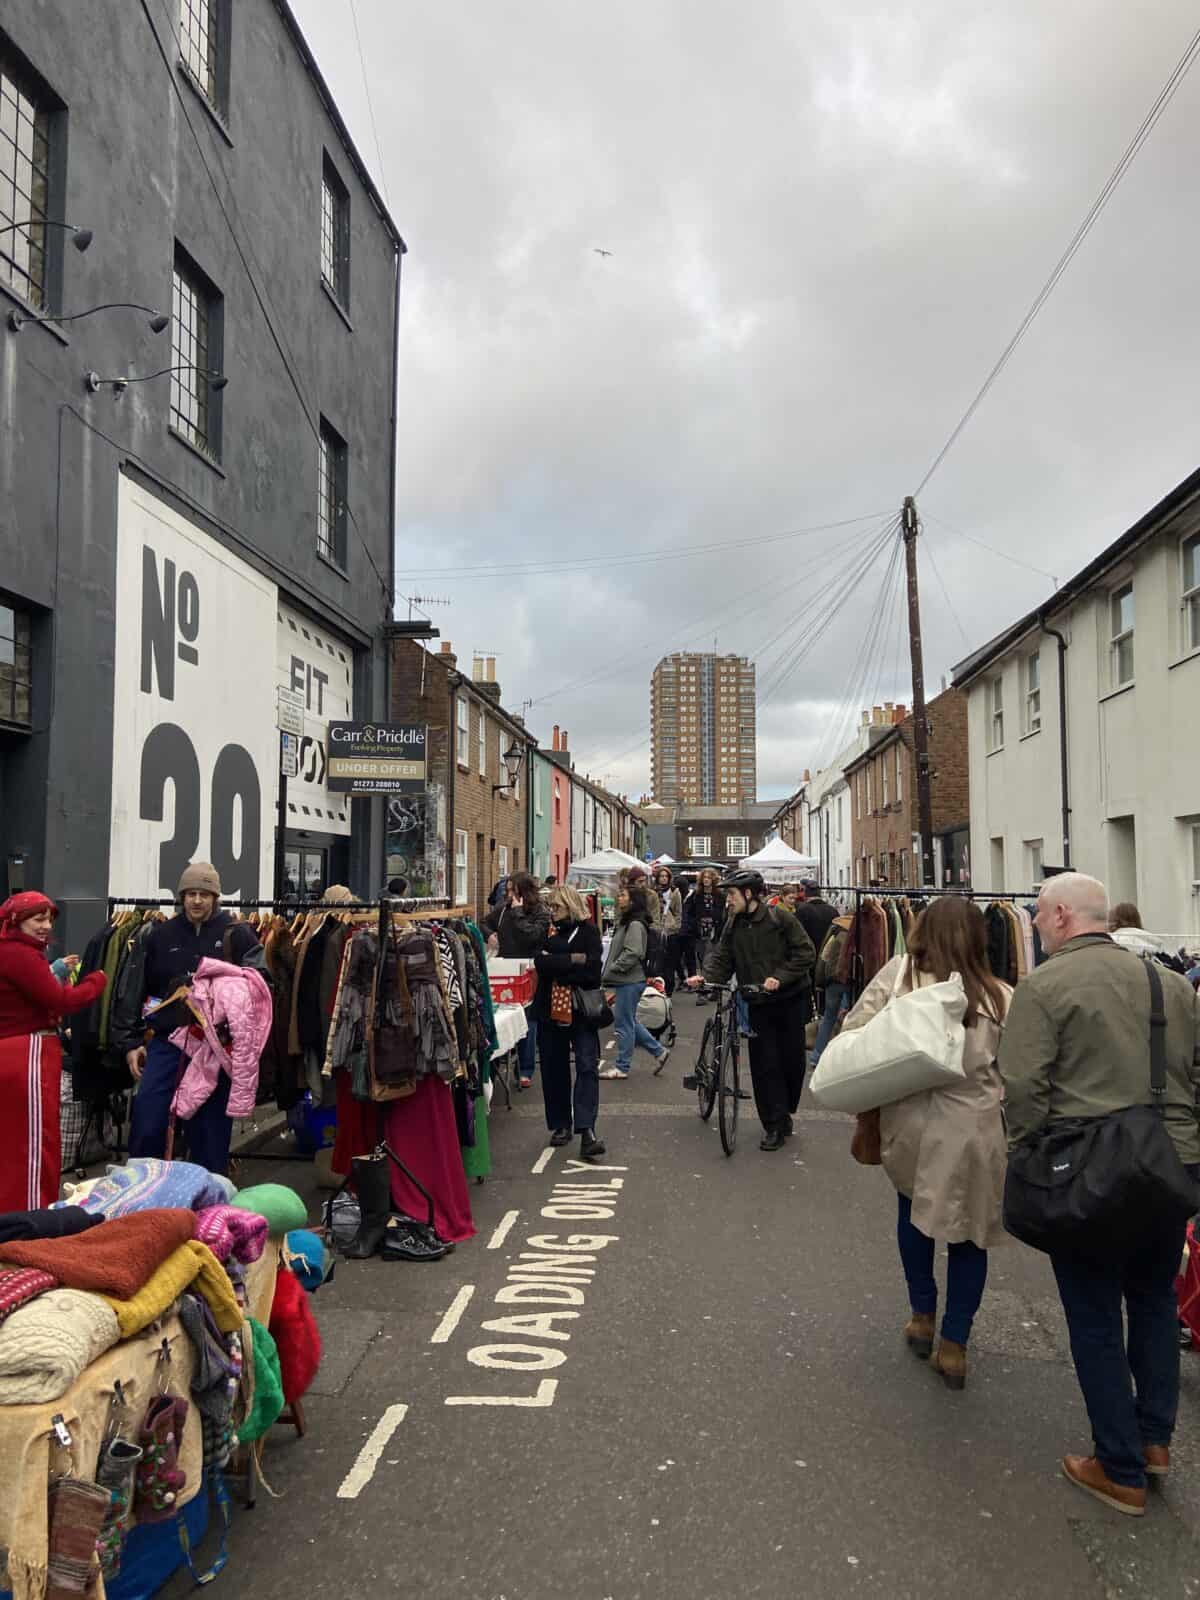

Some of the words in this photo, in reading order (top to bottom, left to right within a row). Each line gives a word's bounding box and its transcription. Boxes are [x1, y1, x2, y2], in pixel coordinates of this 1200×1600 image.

[290, 653, 329, 716] FIT
[331, 727, 362, 742] Carr
[363, 729, 376, 743] &
[377, 729, 425, 744] Priddle
[336, 762, 377, 773] UNDER
[380, 764, 417, 775] OFFER
[353, 780, 374, 788] 01273
[444, 1234, 620, 1407] LOADING
[540, 1159, 629, 1220] ONLY
